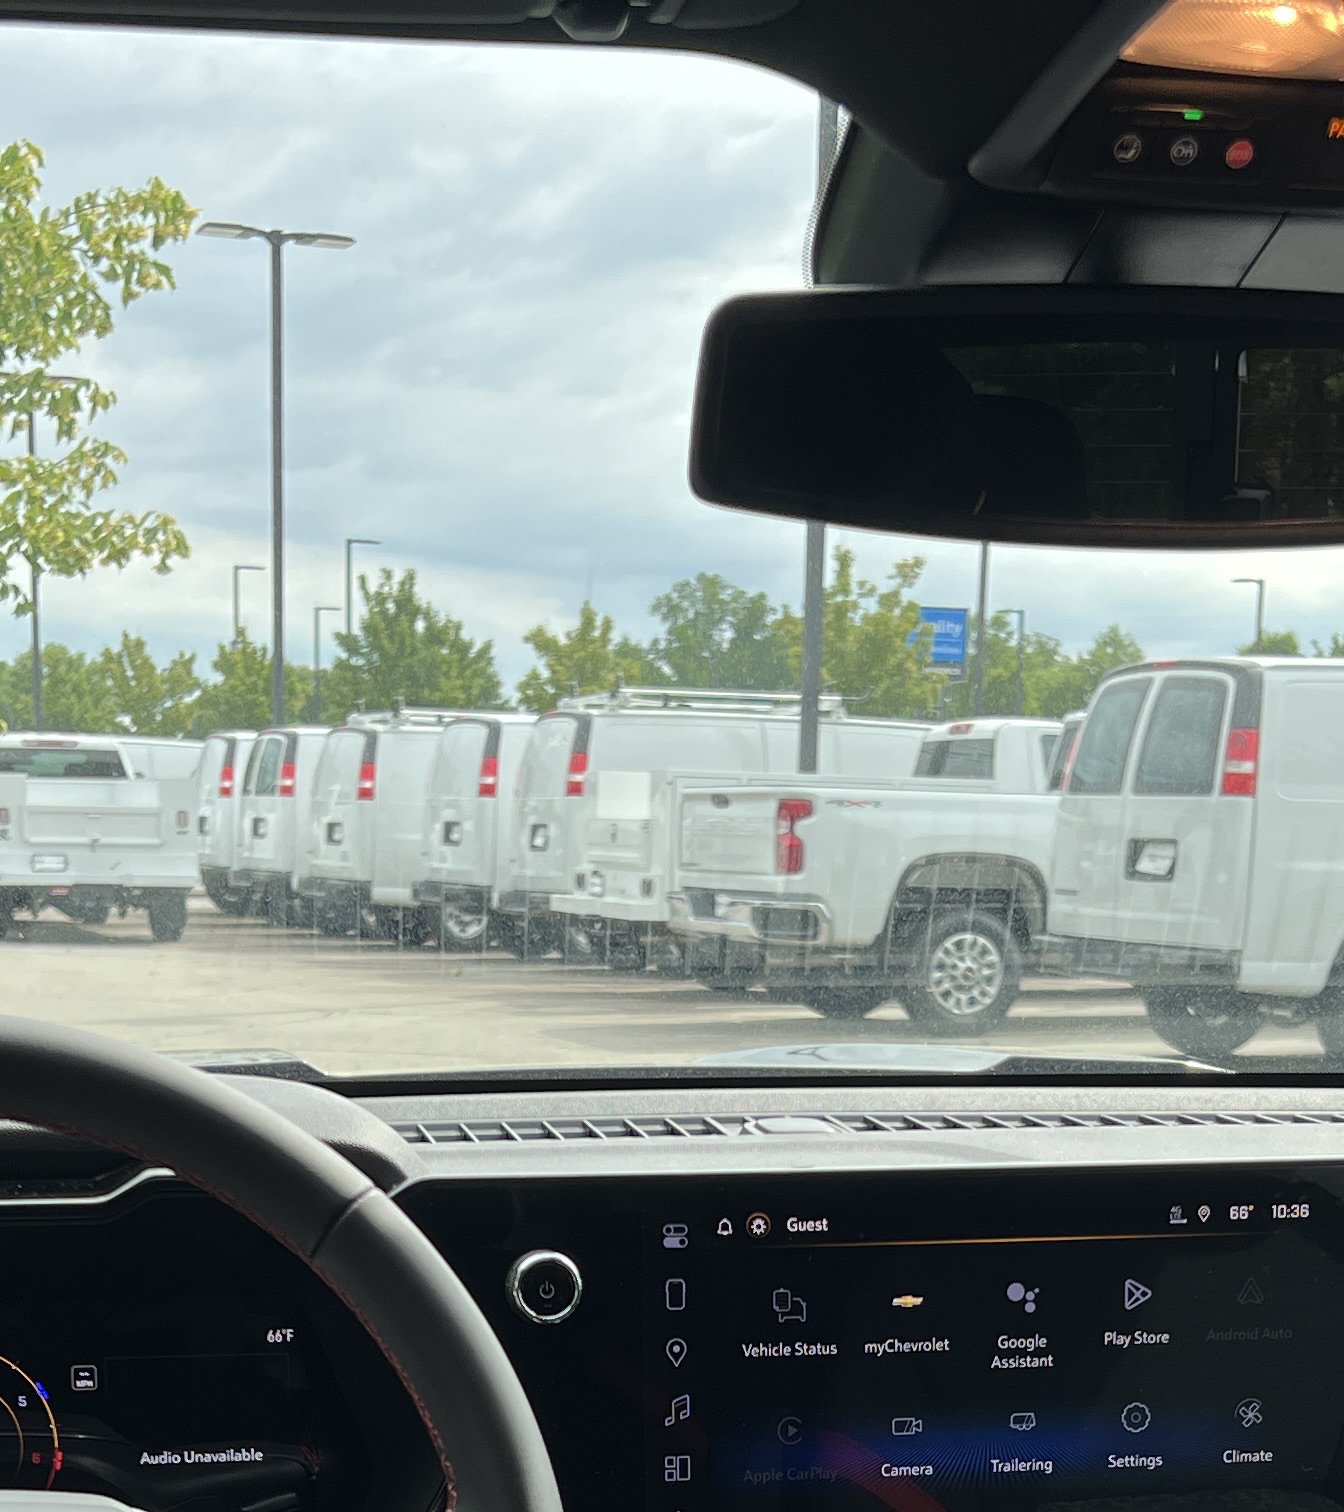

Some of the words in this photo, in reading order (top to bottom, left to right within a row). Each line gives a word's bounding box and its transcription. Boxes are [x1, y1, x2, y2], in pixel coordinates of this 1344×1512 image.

[1229, 1204, 1255, 1220] 66°
[1271, 1203, 1310, 1219] 10:36
[786, 1217, 829, 1233] Guest
[266, 1329, 295, 1343] 66°F
[1104, 1332, 1131, 1348] Play
[1133, 1331, 1170, 1345] Store
[1206, 1328, 1258, 1341] Android
[1261, 1327, 1293, 1340] Auto
[742, 1342, 791, 1357] Vehicle
[794, 1341, 838, 1356] Status
[864, 1338, 950, 1356] myChevrolet
[997, 1334, 1048, 1351] Google
[991, 1355, 1053, 1369] Assistant
[17, 1395, 28, 1408] 5
[31, 1451, 42, 1465] 6
[139, 1450, 182, 1466] Audio
[183, 1448, 264, 1464] Unavailable
[1107, 1454, 1164, 1470] Settings
[1222, 1449, 1274, 1464] Climate
[880, 1463, 934, 1478] Camera
[990, 1459, 1054, 1475] Trailering
[743, 1469, 783, 1484] Apple
[786, 1467, 838, 1482] CarPlay
